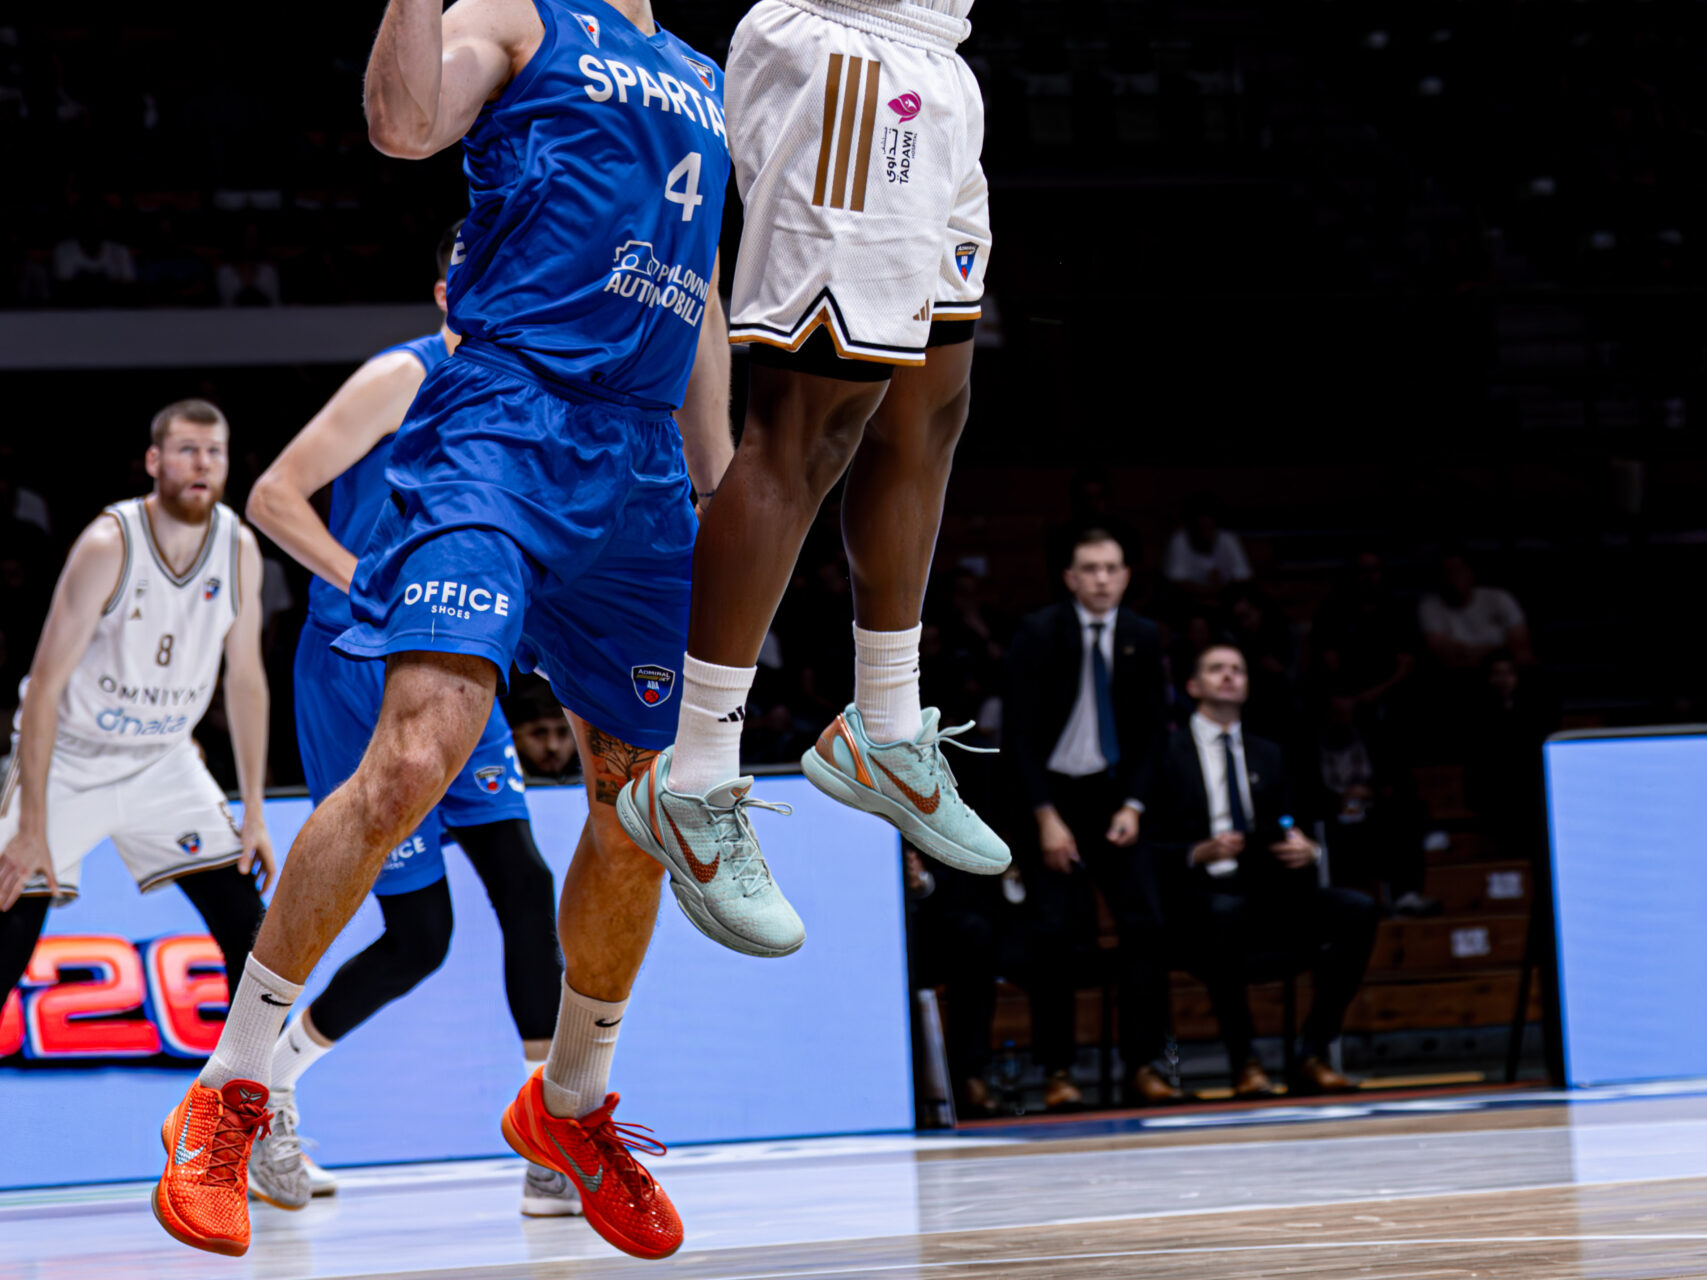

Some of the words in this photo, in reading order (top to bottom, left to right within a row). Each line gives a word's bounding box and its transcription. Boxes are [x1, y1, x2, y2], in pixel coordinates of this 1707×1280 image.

[579, 54, 728, 149] SPARTA
[899, 131, 914, 185] TADAWI
[664, 151, 703, 221] 4
[404, 580, 510, 617] OFFICE
[431, 604, 471, 620] SHOES
[156, 633, 174, 667] 8
